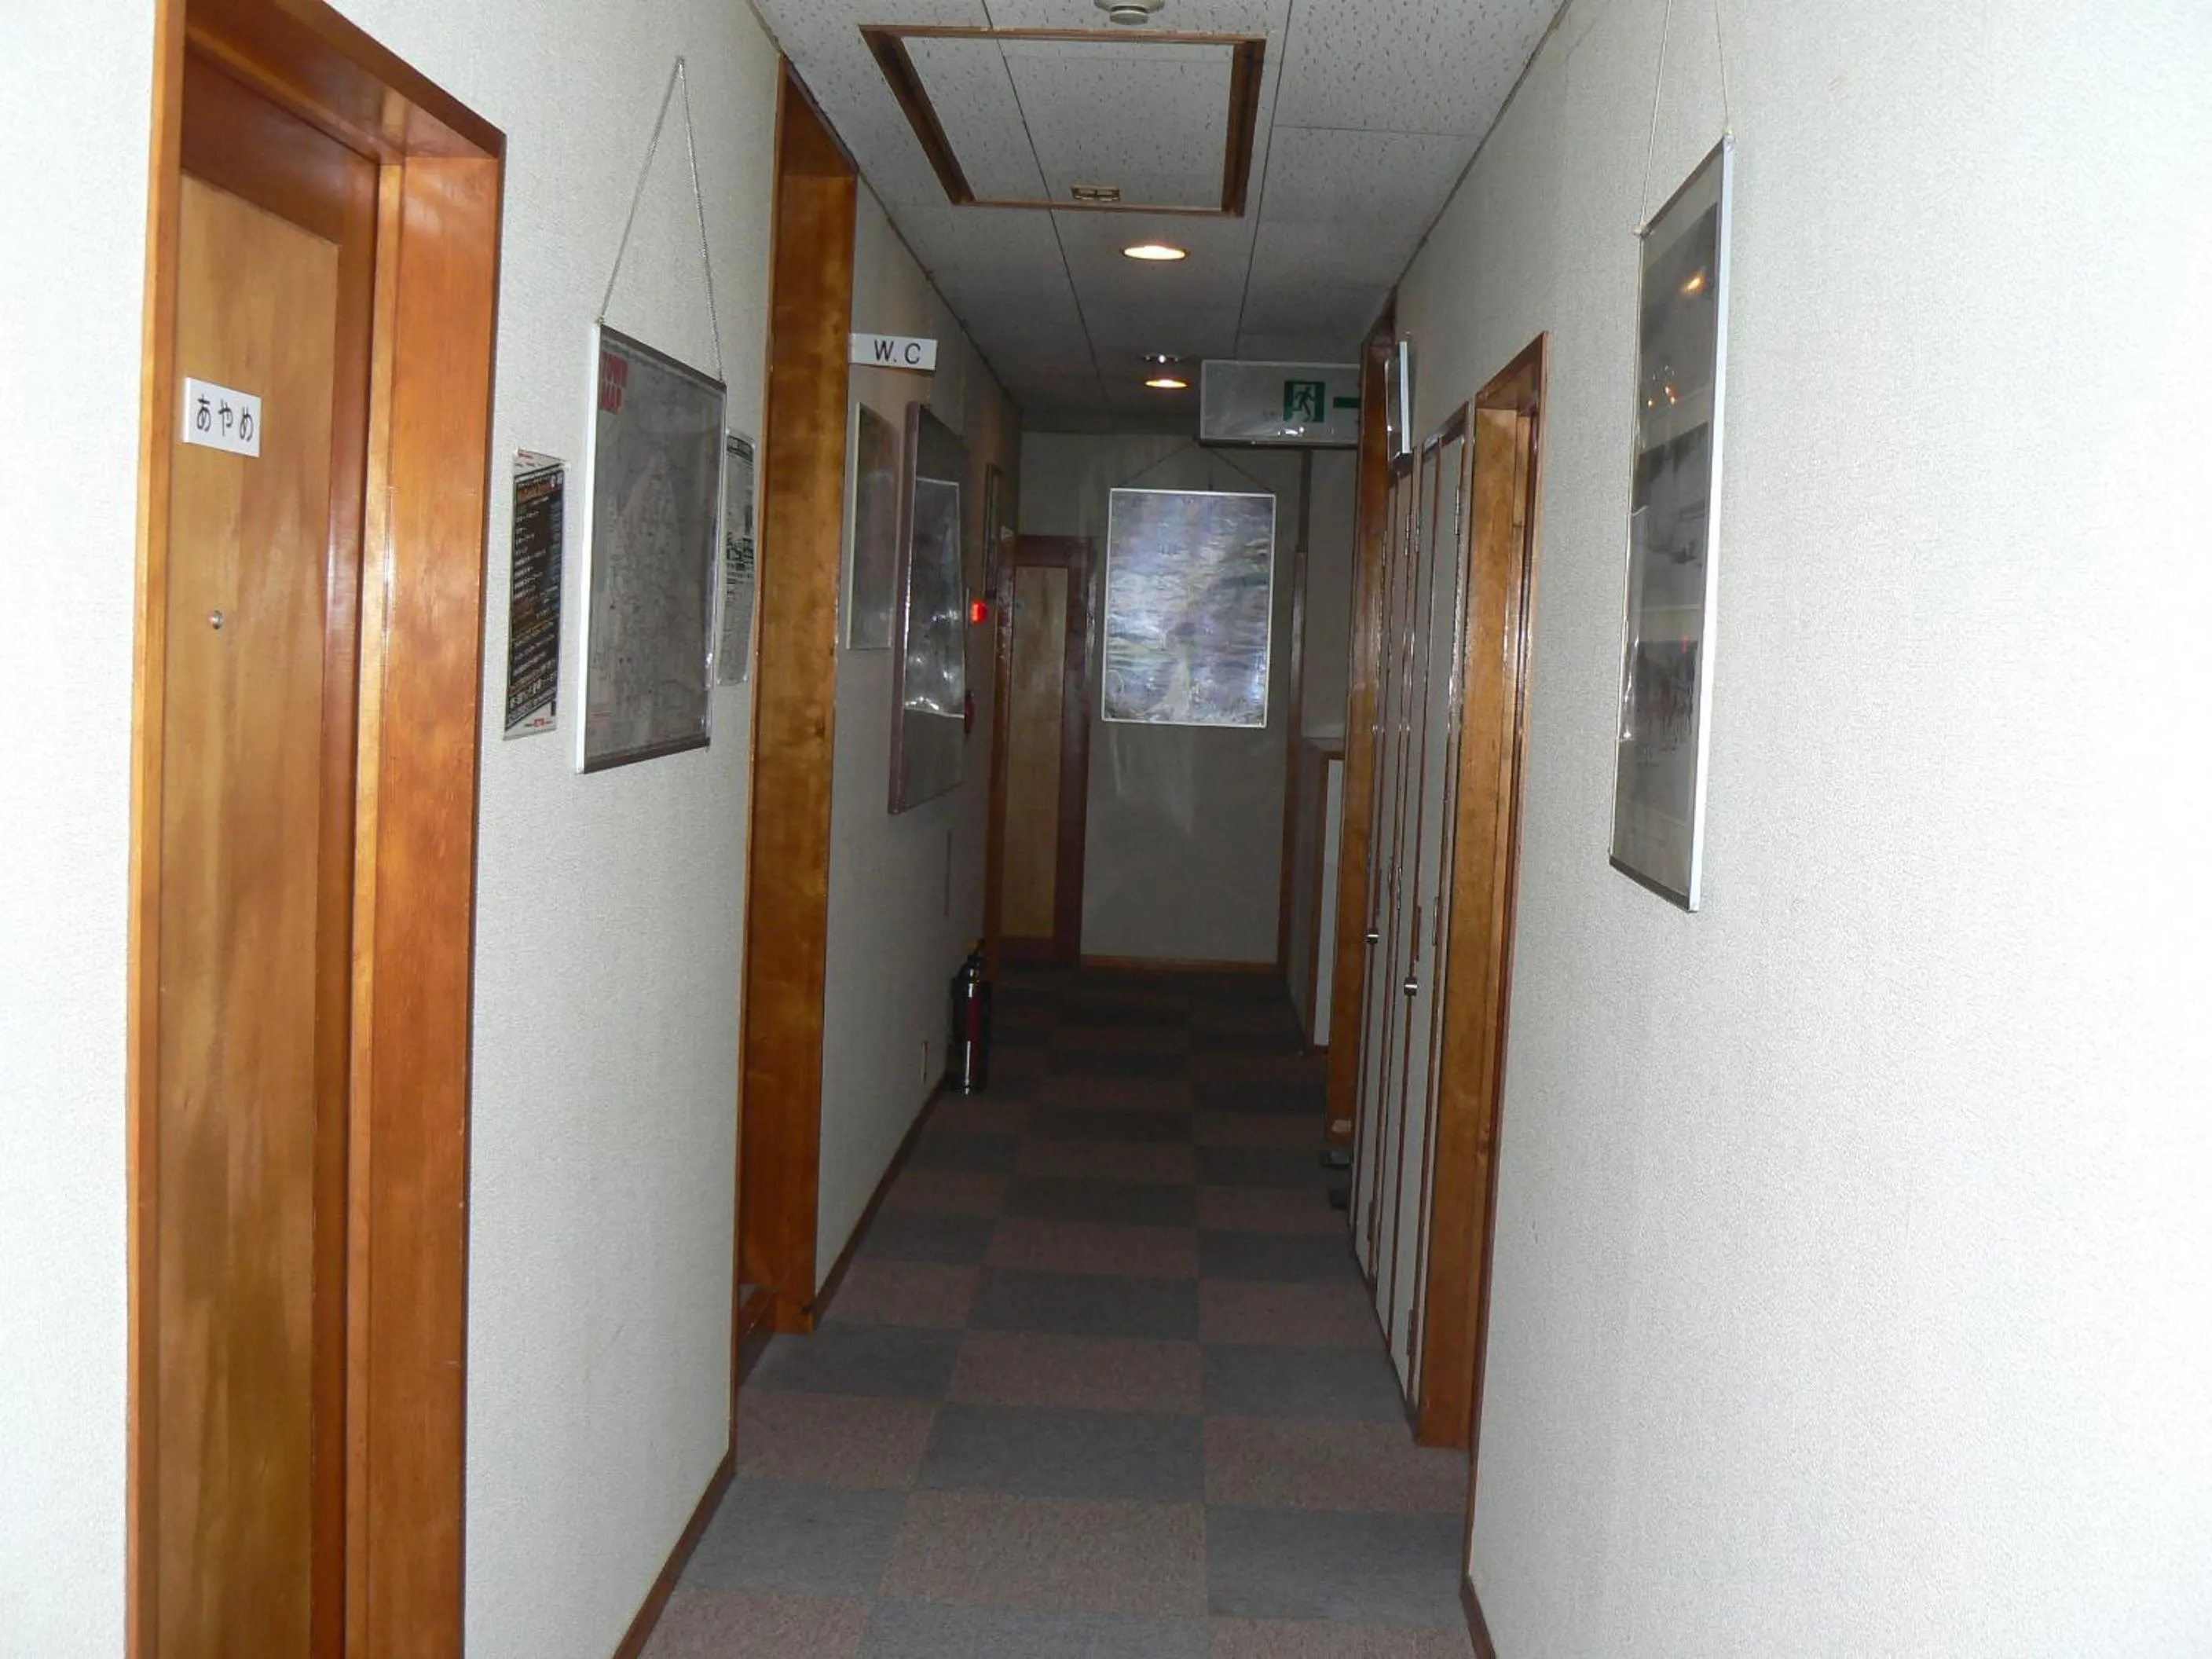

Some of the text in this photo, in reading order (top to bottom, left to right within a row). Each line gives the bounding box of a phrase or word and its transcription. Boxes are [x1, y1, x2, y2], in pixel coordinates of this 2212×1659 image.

[874, 339, 921, 364] W.C
[196, 394, 254, 441] あやめ
